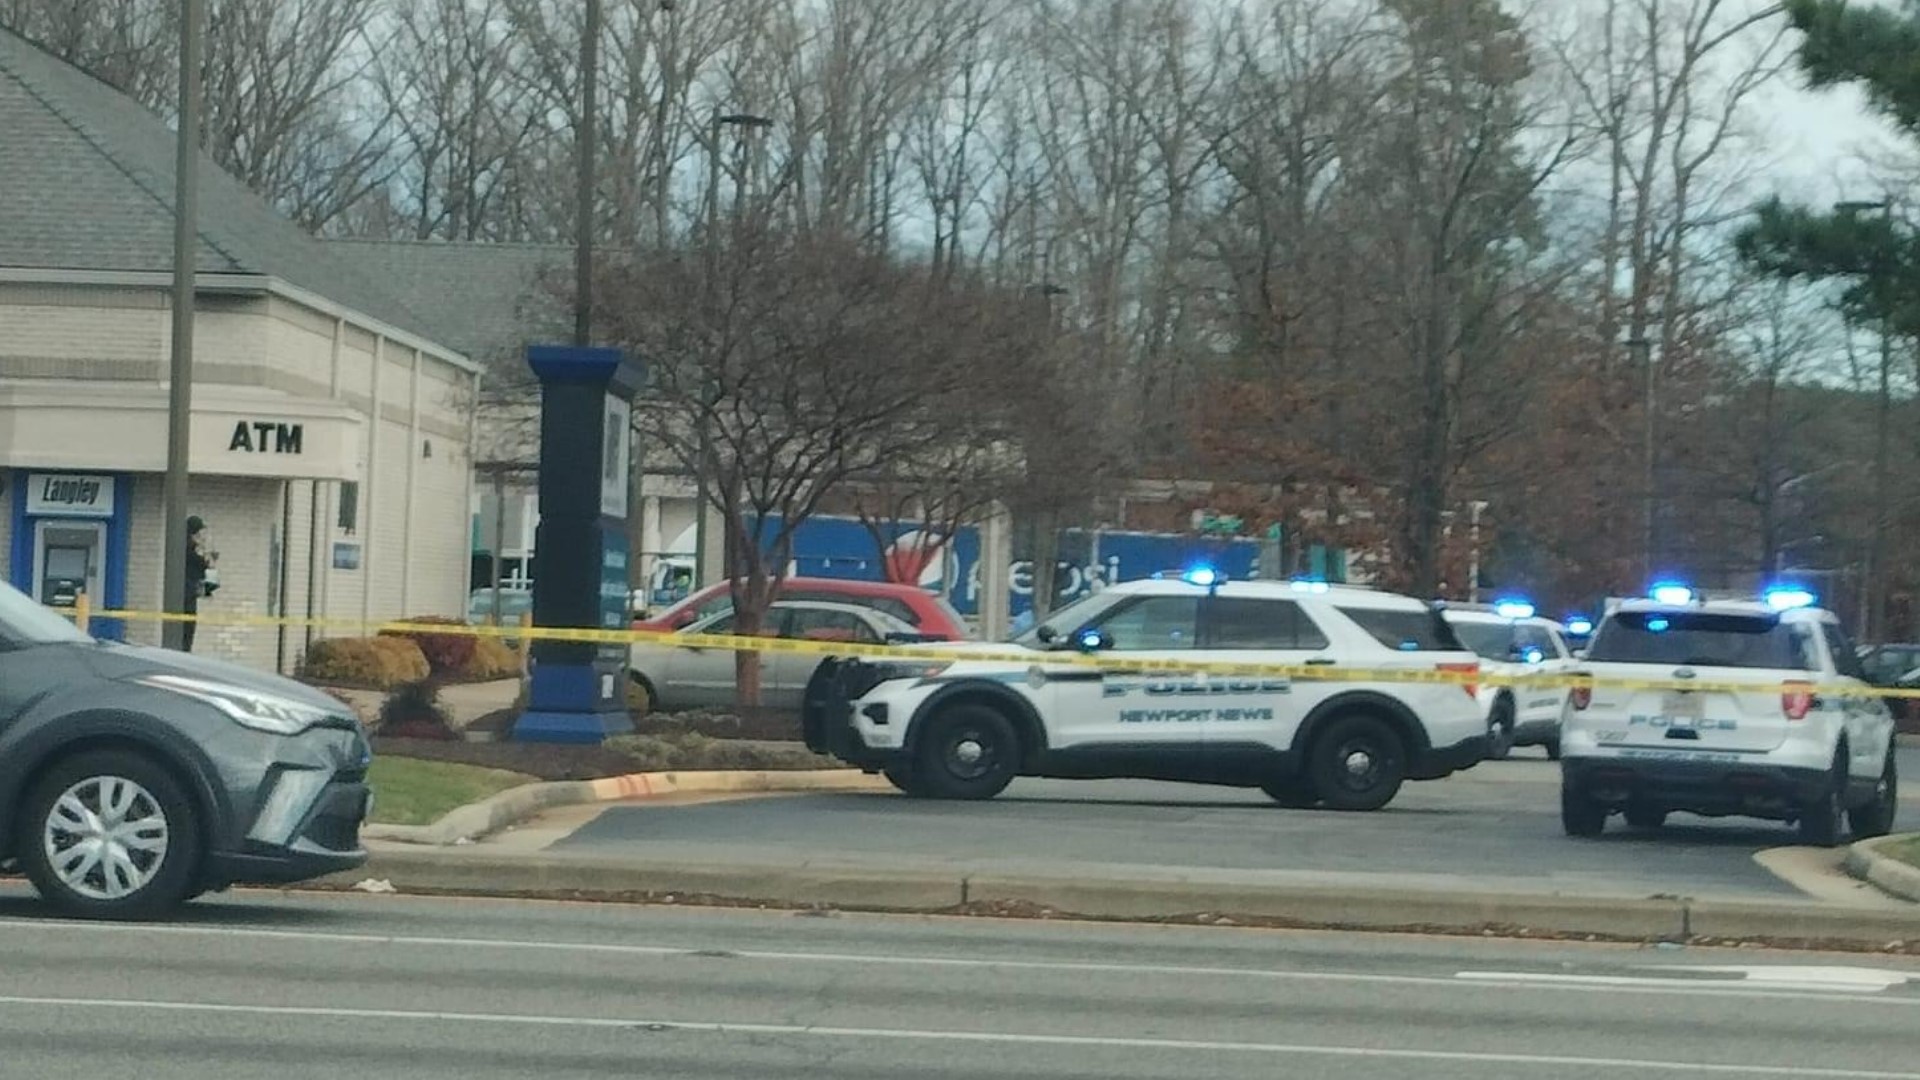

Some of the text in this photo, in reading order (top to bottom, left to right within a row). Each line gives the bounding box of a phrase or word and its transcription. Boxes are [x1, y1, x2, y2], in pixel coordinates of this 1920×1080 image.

[229, 421, 303, 454] ATM
[43, 478, 100, 505] Langley
[1119, 708, 1273, 722] NEWPORT NEWS
